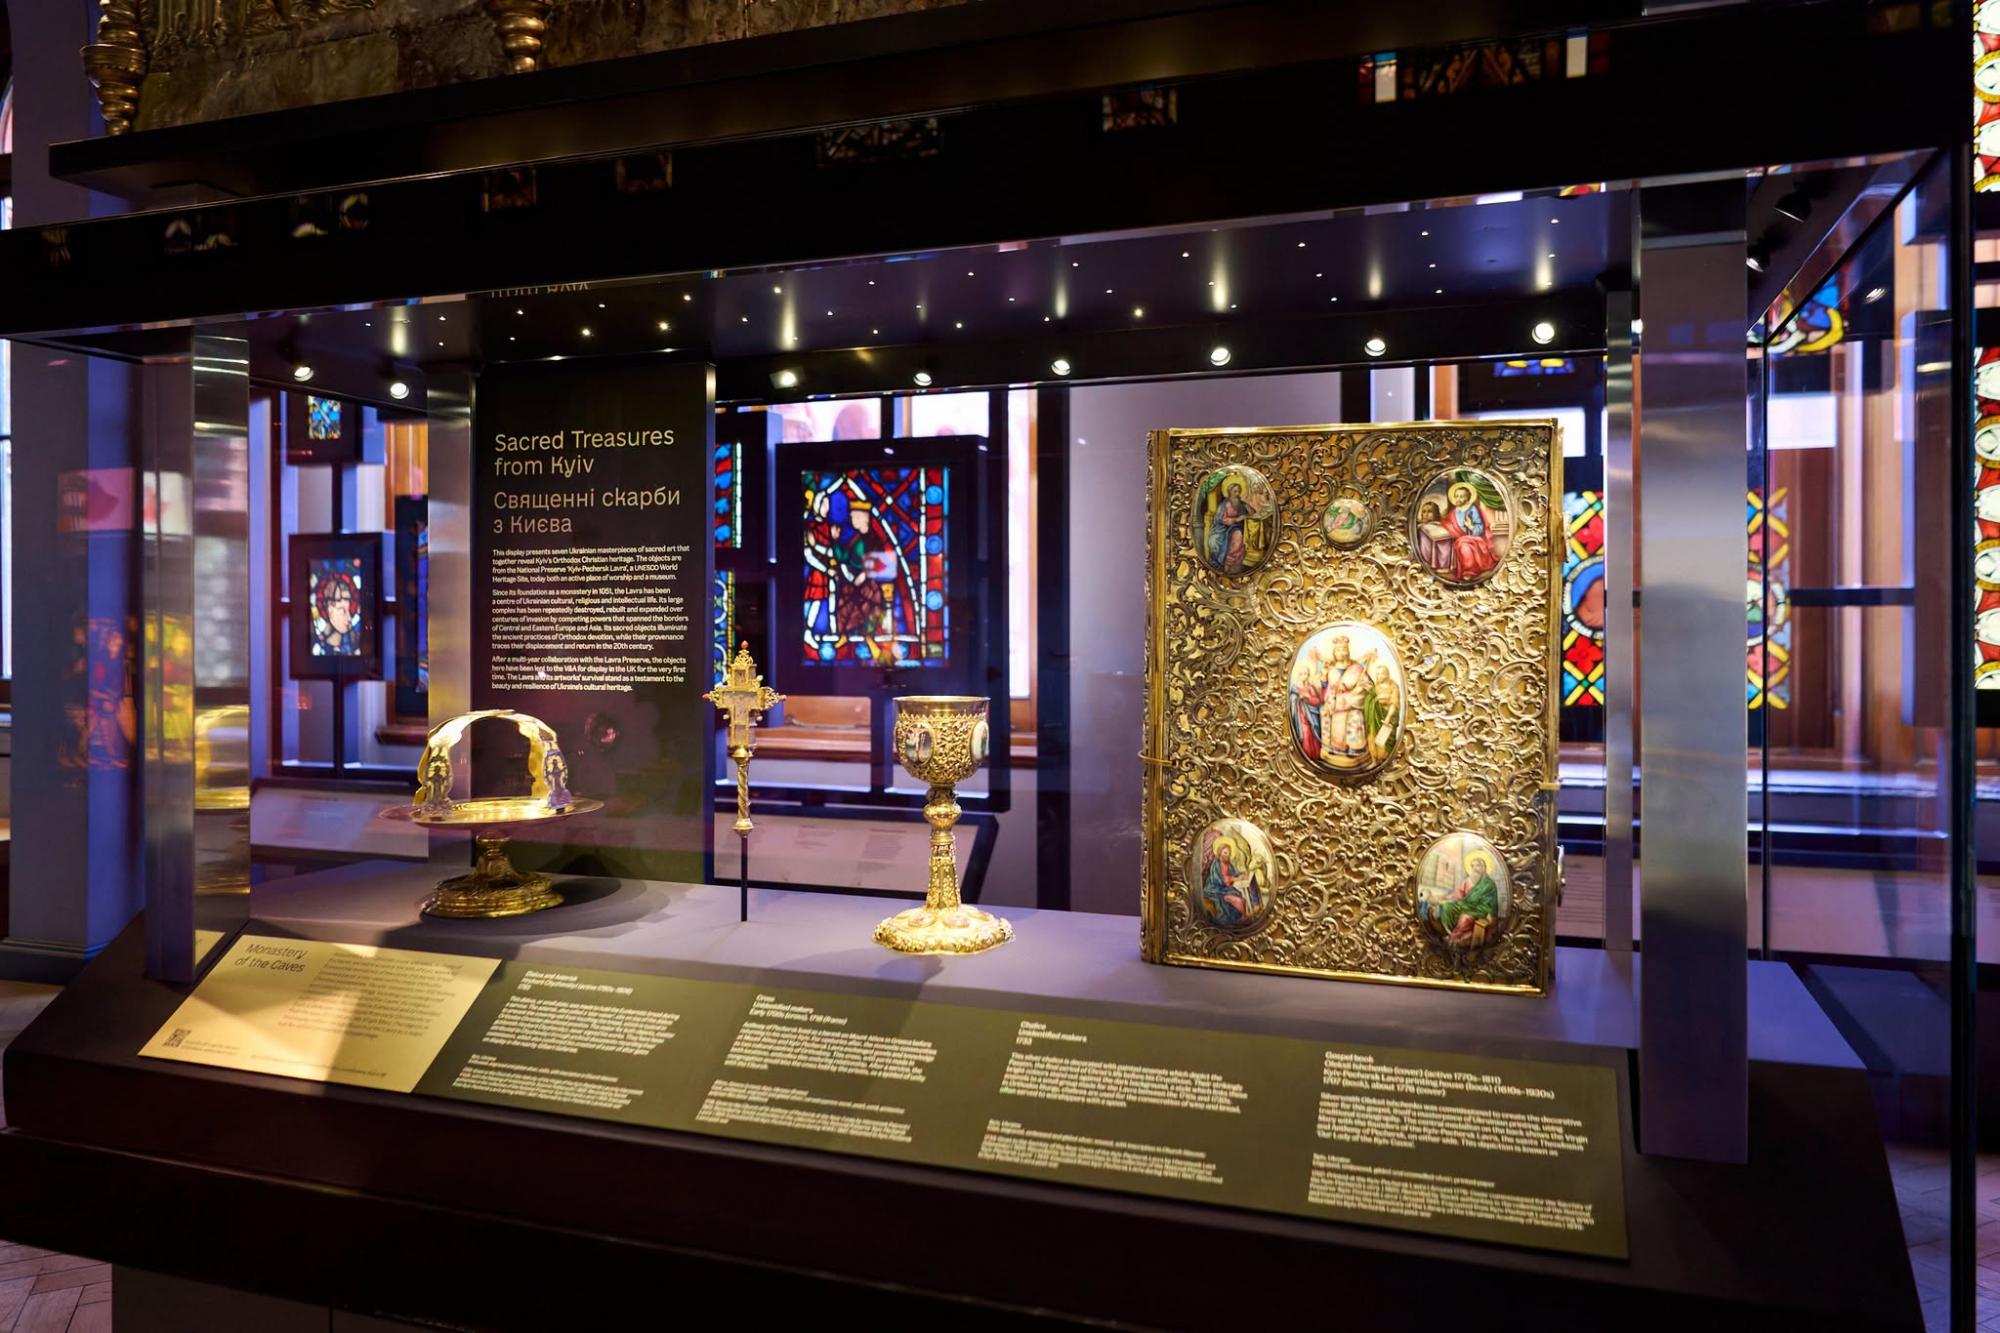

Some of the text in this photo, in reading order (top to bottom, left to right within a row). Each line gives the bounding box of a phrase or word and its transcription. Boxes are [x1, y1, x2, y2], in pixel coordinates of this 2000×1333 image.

[495, 429, 674, 451] Sacred Treasures
[494, 455, 594, 478] from Kyiv
[494, 486, 680, 511] Священні скарби
[493, 515, 572, 534] з Києва
[505, 549, 524, 557] display
[525, 548, 550, 556] presents
[492, 558, 516, 566] together
[647, 555, 670, 563] objects
[608, 574, 632, 582] worship
[246, 944, 308, 960] Monastery
[234, 956, 306, 972] of the Caves
[1018, 1029, 1061, 1039] Unidentified
[1325, 1051, 1374, 1062] Gospel book
[1394, 1066, 1423, 1077] (cover)
[1405, 1076, 1437, 1088] printing
[1439, 1079, 1464, 1088] house
[1466, 1082, 1492, 1093] (book)
[1416, 1085, 1445, 1097] (cover)
